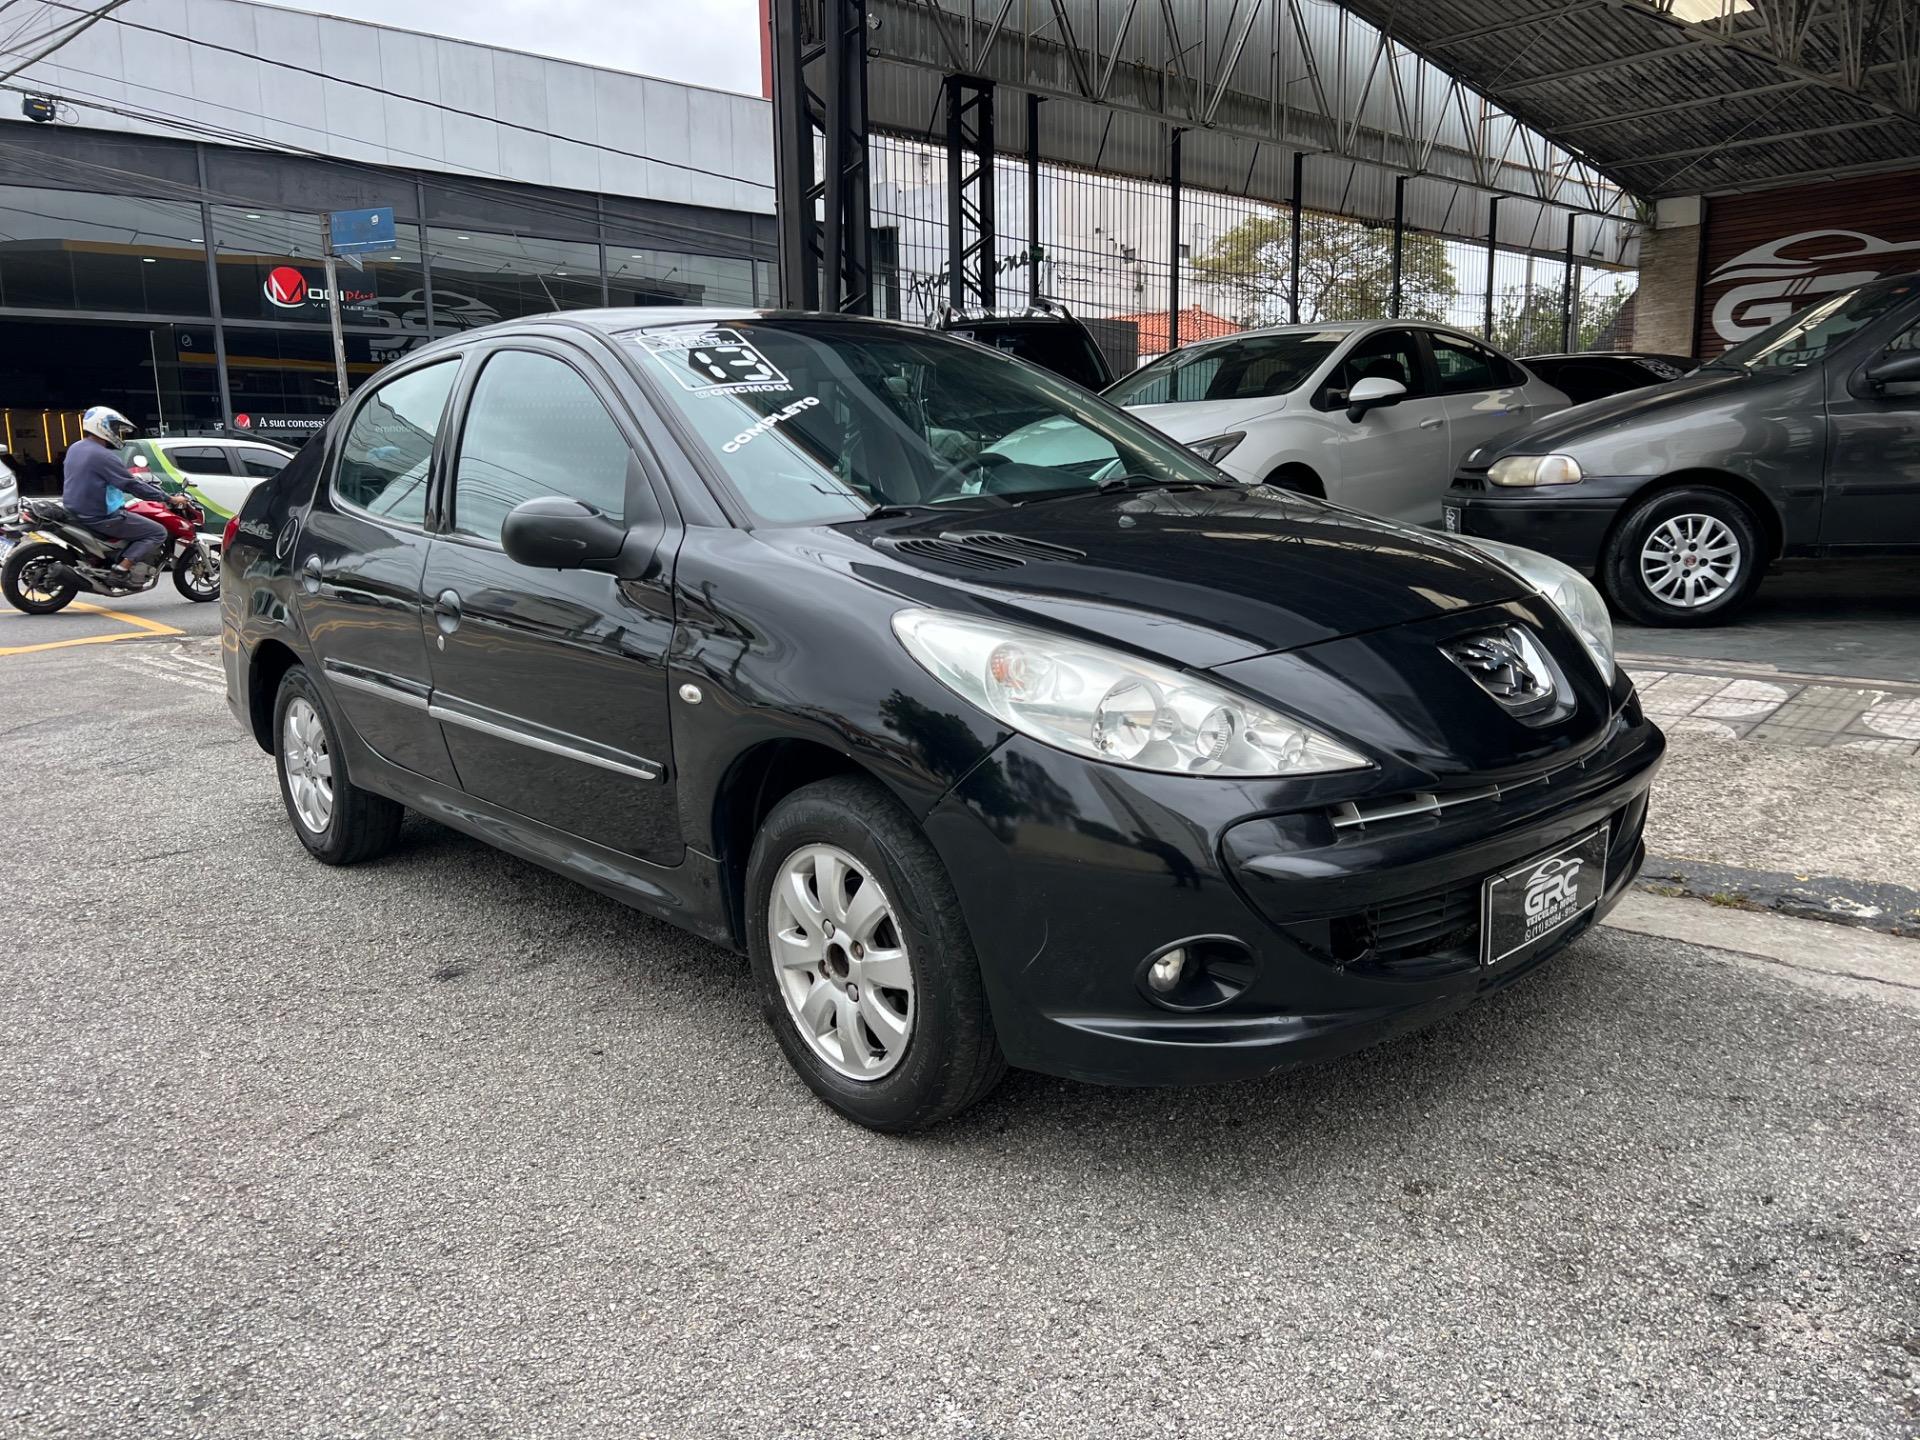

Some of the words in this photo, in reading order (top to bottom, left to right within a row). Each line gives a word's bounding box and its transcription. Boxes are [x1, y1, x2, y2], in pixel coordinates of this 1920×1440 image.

[259, 417, 267, 428] A
[269, 419, 286, 428] sua
[721, 395, 820, 454] COMPLETO
[1524, 864, 1580, 917] GRC
